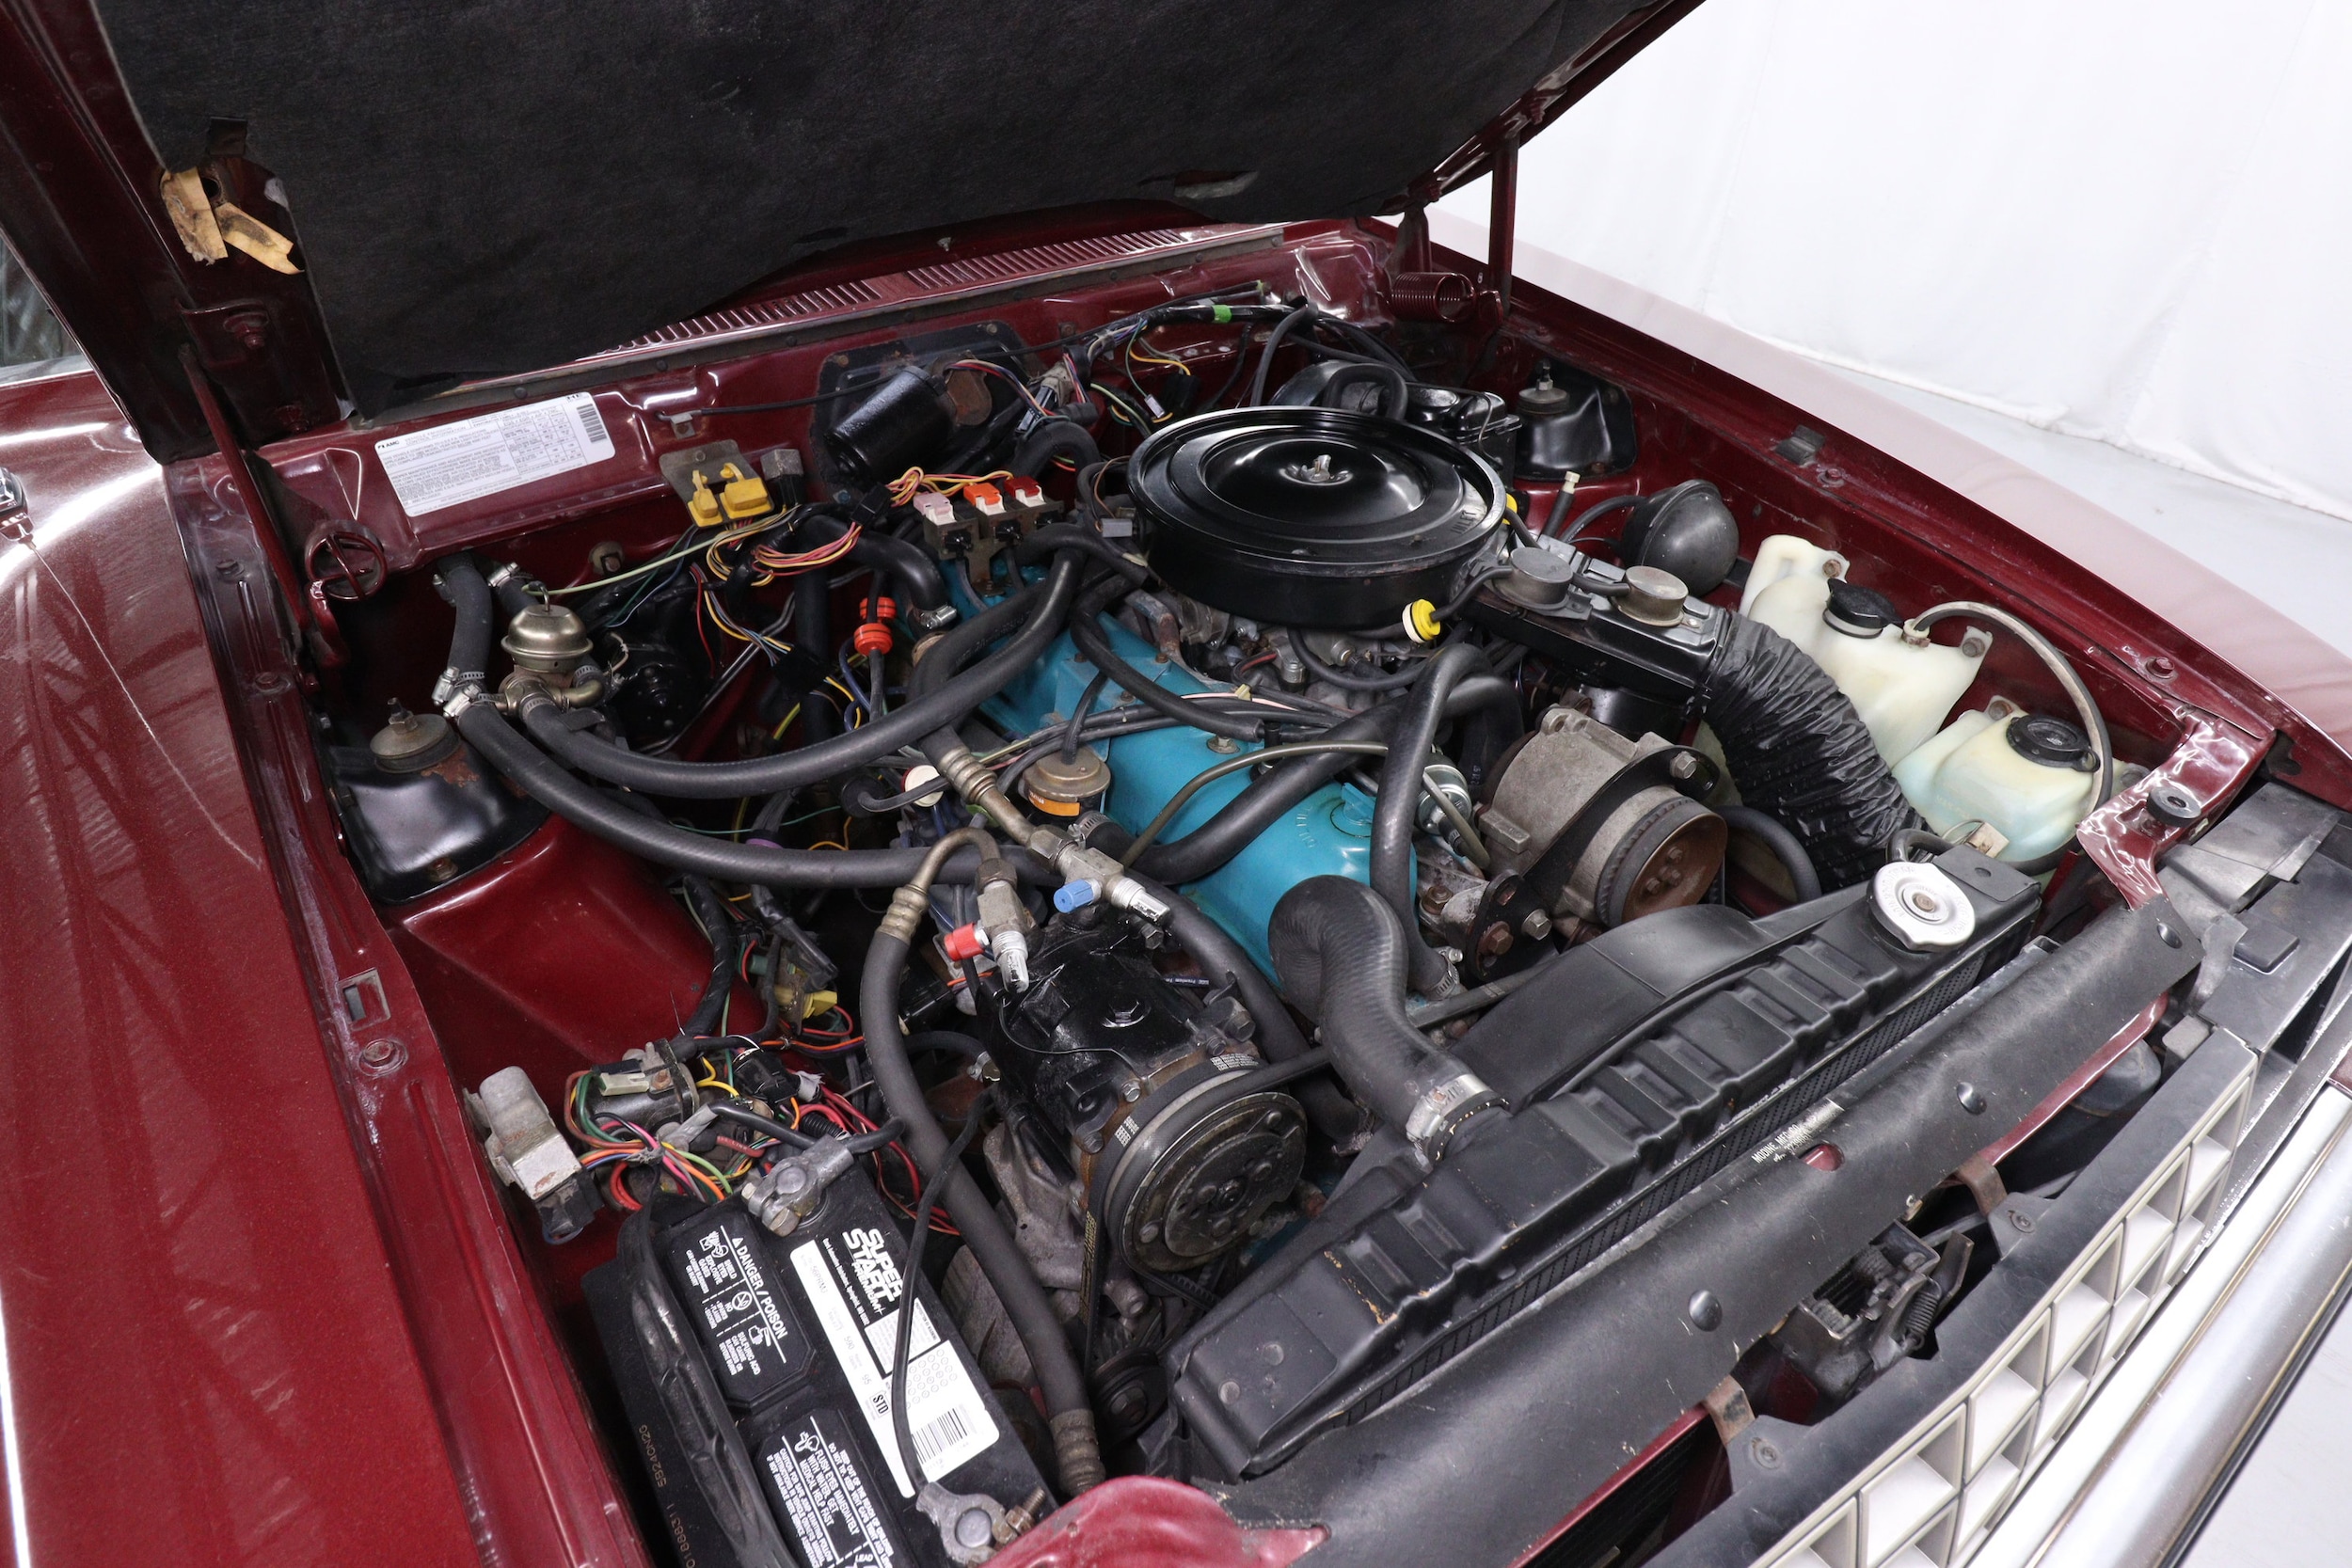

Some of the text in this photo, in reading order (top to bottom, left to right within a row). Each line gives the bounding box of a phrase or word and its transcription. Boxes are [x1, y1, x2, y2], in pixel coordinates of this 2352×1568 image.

[704, 1254, 723, 1285] EXPLOSIVE
[716, 1262, 728, 1278] EYES
[723, 1259, 738, 1279] SHIELD
[842, 1227, 895, 1308] START
[862, 1228, 904, 1298] SUPER
[724, 1302, 734, 1312] NO
[737, 1244, 764, 1291] DANGER
[760, 1296, 788, 1339] POISON
[736, 1331, 761, 1375] SULFURIC ACID
[842, 1335, 855, 1350] 590
[861, 1372, 872, 1386] 95
[873, 1394, 888, 1414] STD
[797, 1459, 834, 1527] MEDICAL HELP FAST
[805, 1453, 820, 1474] WITH
[825, 1497, 839, 1513] GET
[813, 1449, 860, 1535] FLUSH EYES IMMEDIATELY
[855, 1554, 873, 1562] LEAD
